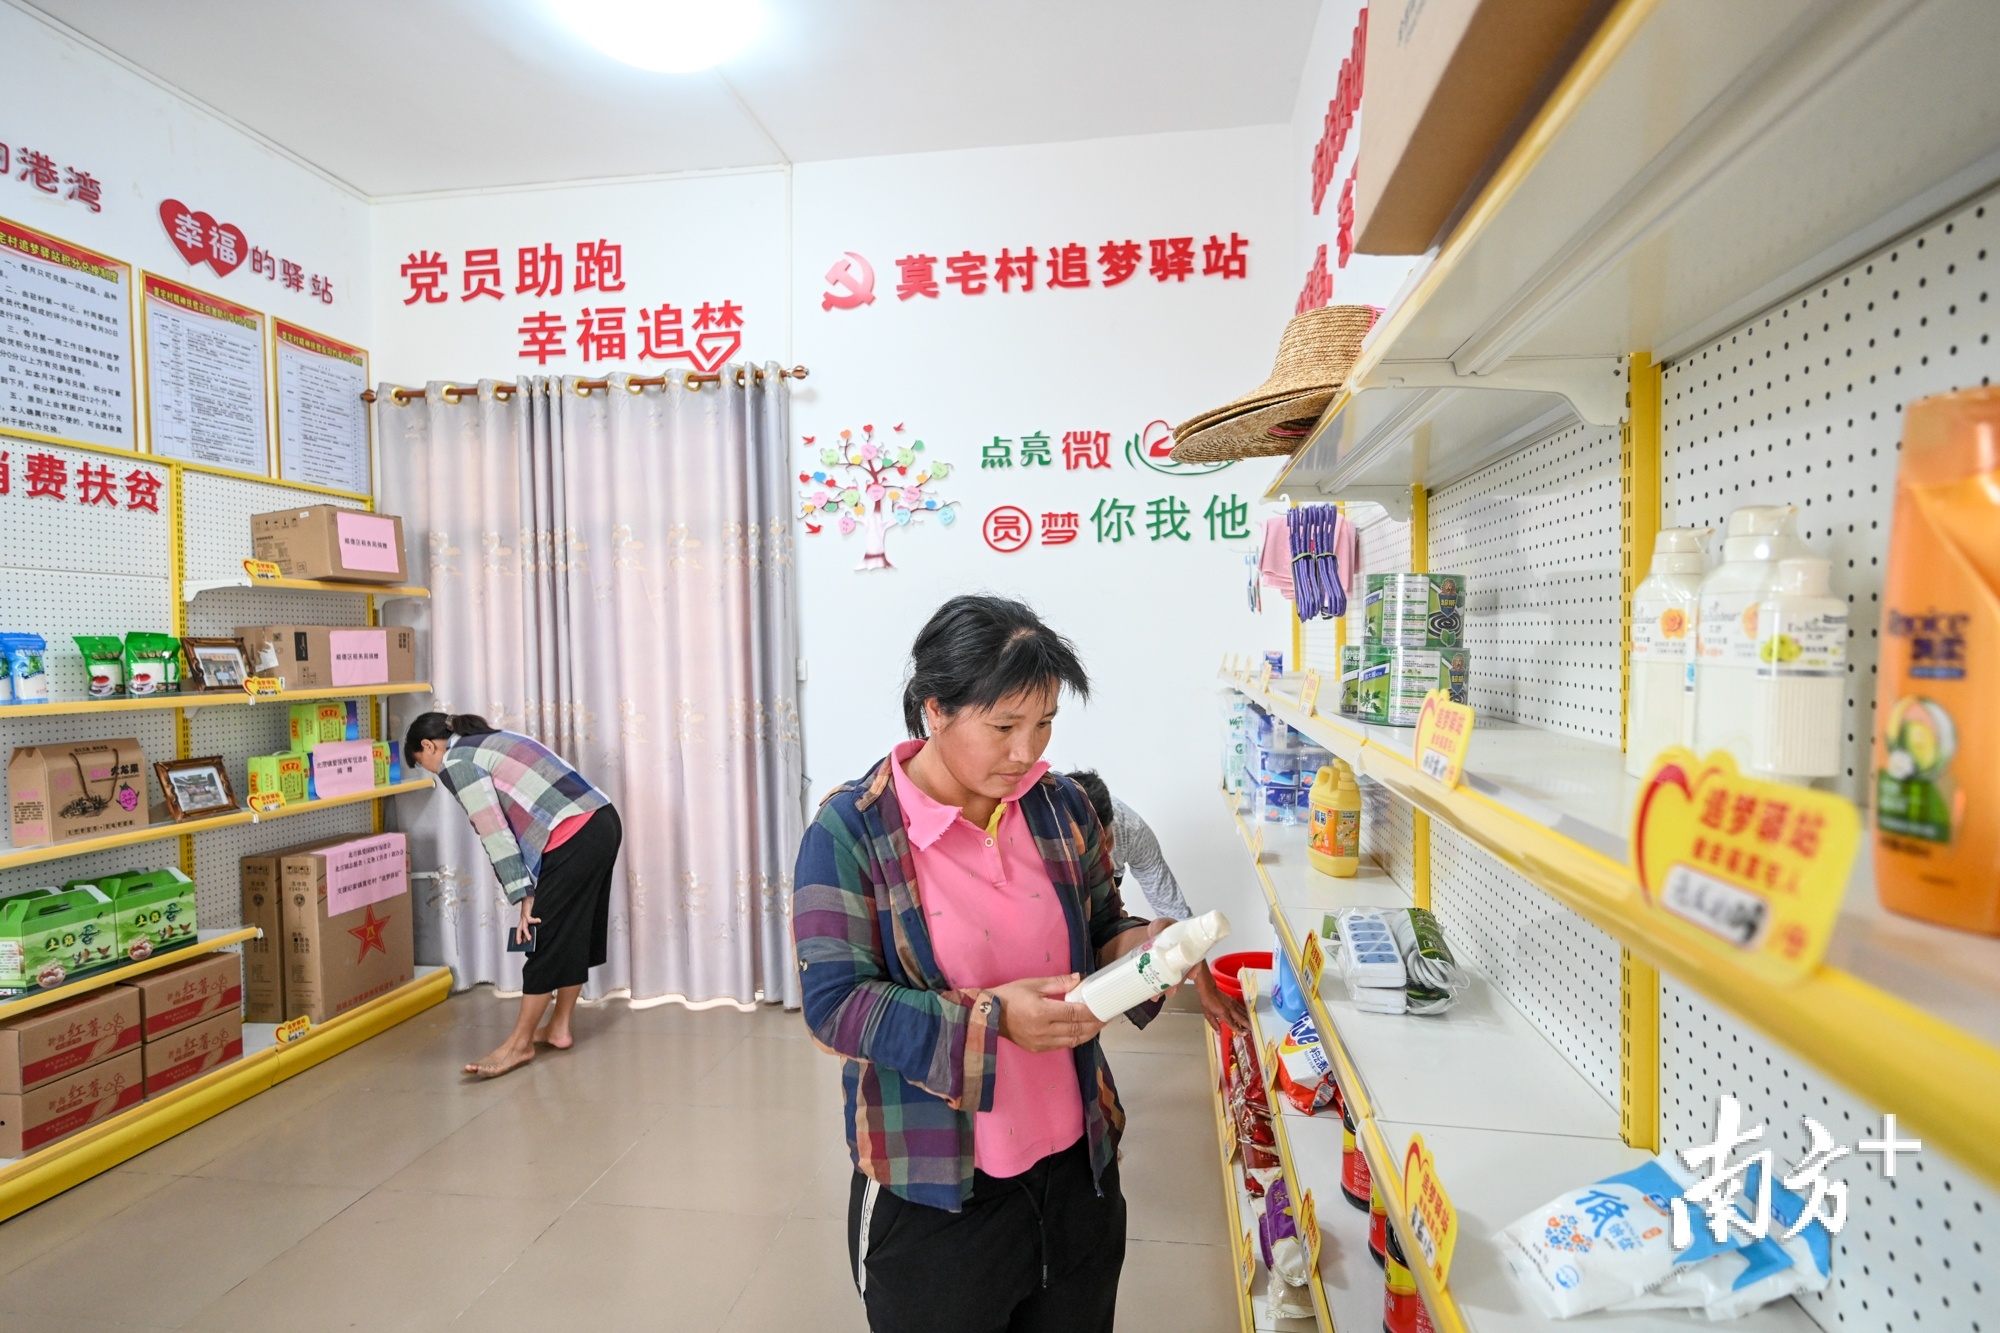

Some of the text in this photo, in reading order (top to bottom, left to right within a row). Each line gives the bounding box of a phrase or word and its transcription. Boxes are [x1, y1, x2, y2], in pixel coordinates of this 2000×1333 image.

[401, 239, 626, 305] 党员助跑
[896, 233, 1249, 301] 莫宅村追梦驿站
[518, 300, 744, 372] 幸福追梦
[981, 430, 1112, 470] 点亮微
